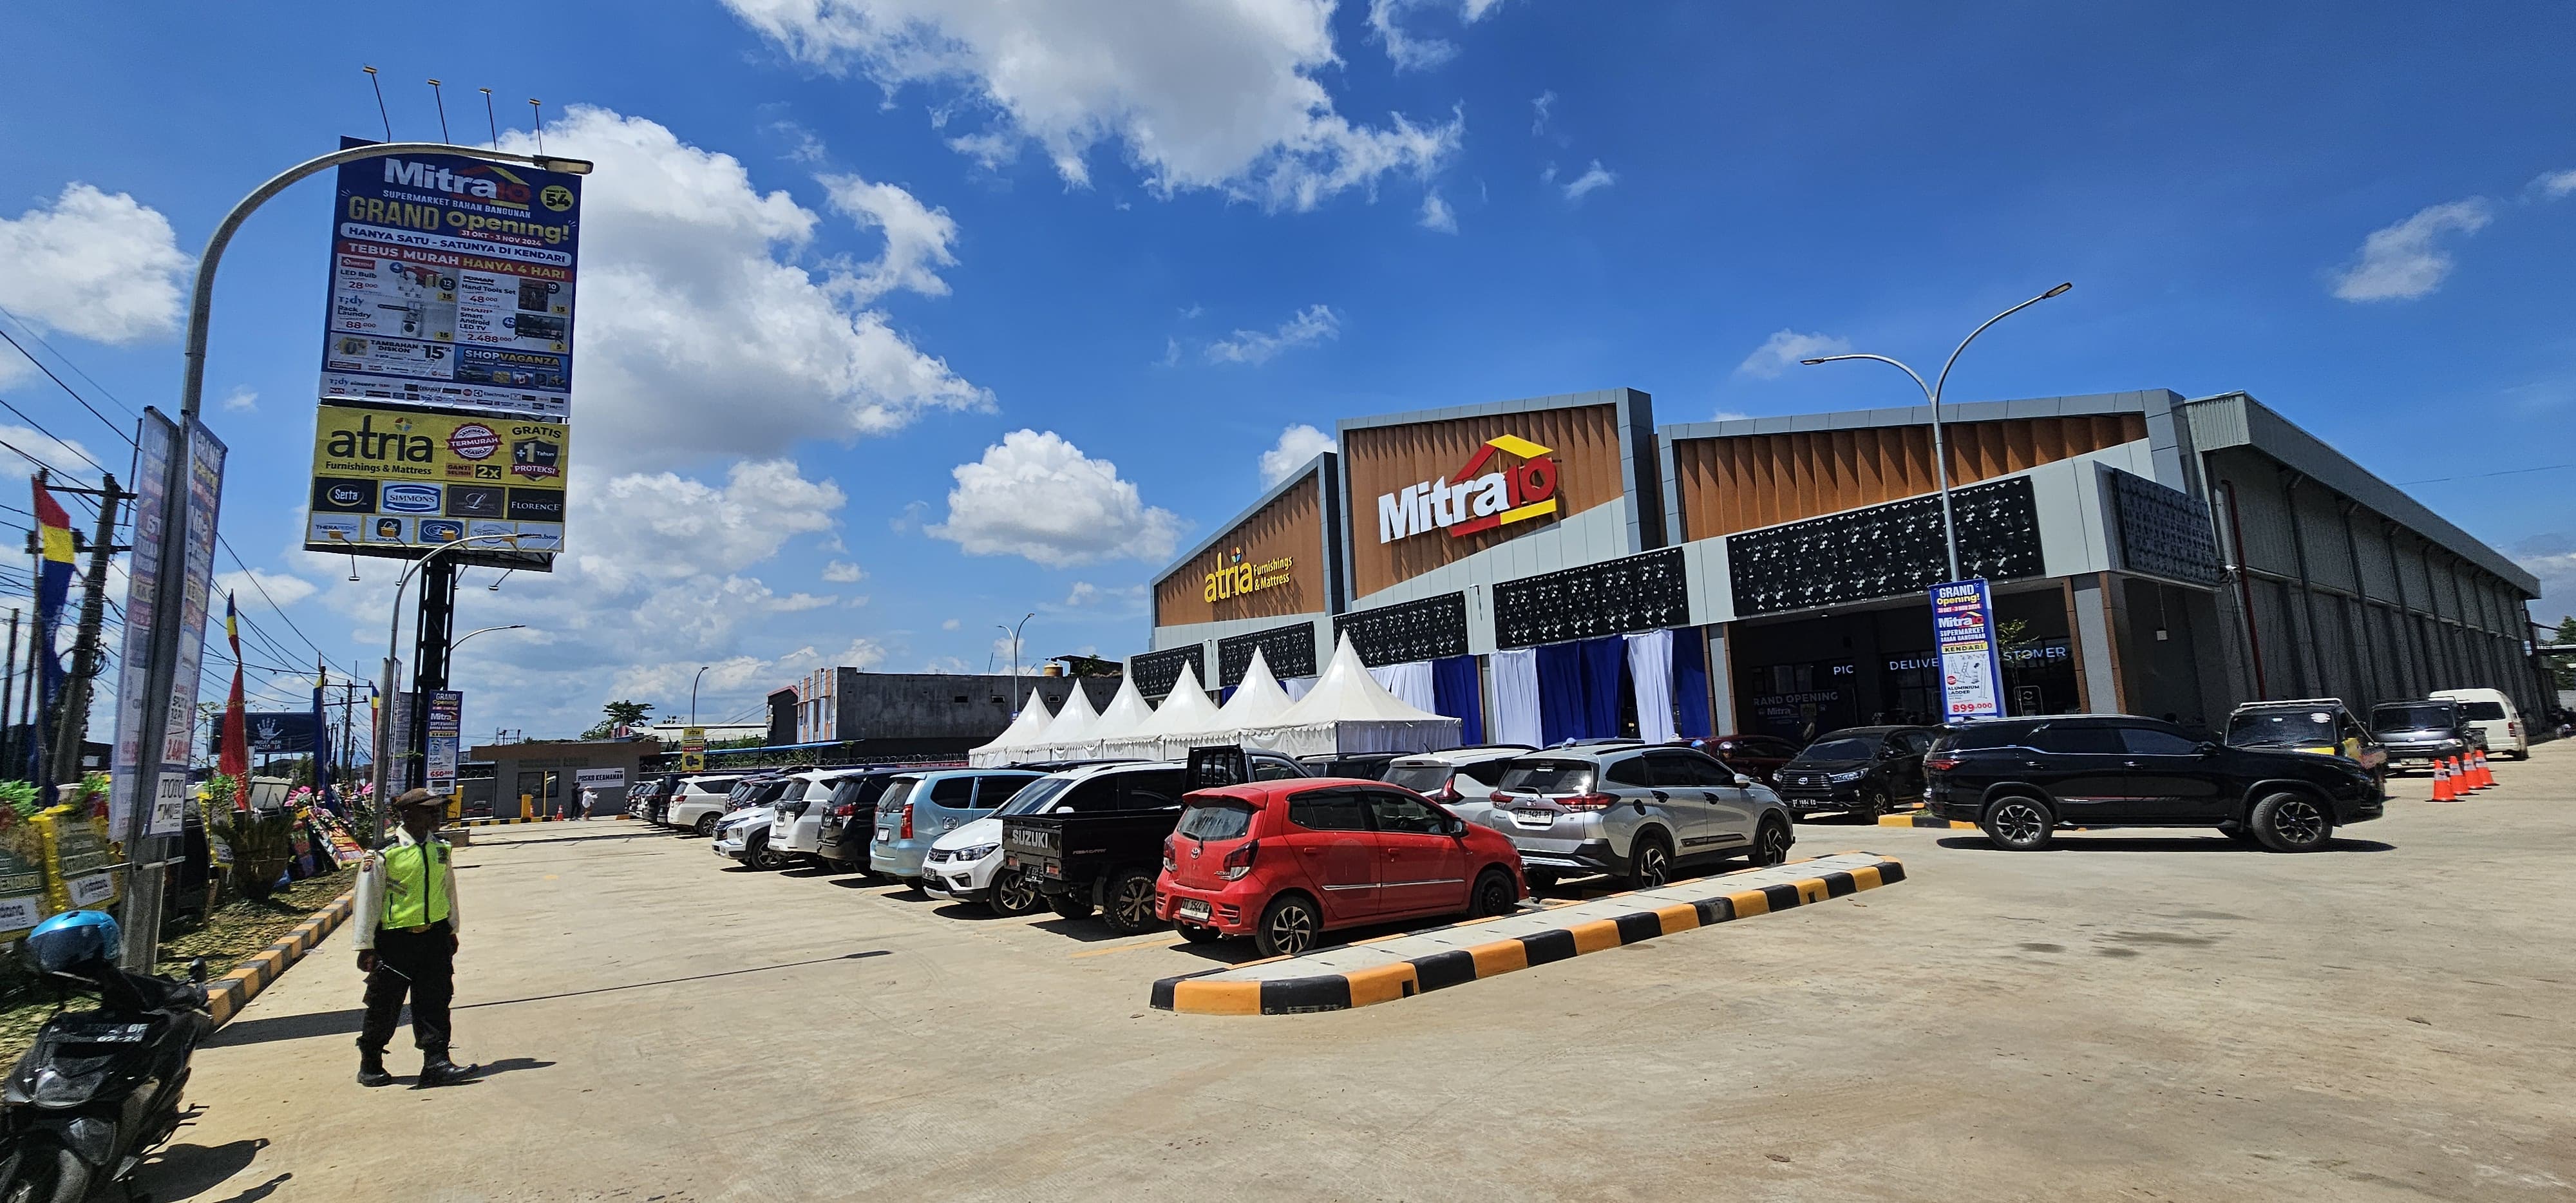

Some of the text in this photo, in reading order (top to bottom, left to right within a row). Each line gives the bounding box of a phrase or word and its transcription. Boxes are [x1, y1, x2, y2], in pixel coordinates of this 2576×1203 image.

[383, 190, 531, 219] SUPERMARKET BAHAN BANGUNAN
[546, 193, 571, 207] 54
[348, 196, 570, 245] GRAND Opening!
[348, 226, 393, 242] HANYA
[397, 232, 430, 245] SATU
[440, 239, 497, 255] SATUNYA
[499, 246, 511, 256] DI
[514, 248, 566, 263] KENDARI
[472, 231, 489, 240] OKT
[502, 235, 520, 245] NOV
[522, 238, 542, 247] 2024
[348, 242, 565, 279] TEBUS MURAH HANYA 4 HARI
[484, 285, 502, 294] Tools
[337, 310, 372, 319] Laundry
[460, 317, 490, 326] Android
[370, 339, 419, 350] TAMBAHAN
[464, 350, 560, 366] SHOPVAGANZA
[327, 415, 433, 463] atria
[512, 426, 562, 439] GRATIS
[451, 437, 498, 447] TERMURAH
[326, 461, 381, 473] Furnishings
[392, 465, 432, 475] Mattress
[515, 465, 556, 475] PROTEKSI
[335, 489, 358, 500] Serta
[390, 495, 435, 503] SIMMONS
[1378, 457, 1558, 544] Mitra10
[511, 501, 562, 511] FLORENCE
[1253, 556, 1293, 576] Furnishings
[1204, 552, 1253, 603] atria
[1255, 573, 1290, 591] & Mattress
[1939, 585, 1975, 598] GRAND
[1937, 592, 1980, 607] Opening!
[1938, 616, 1984, 628] Mitra10
[1940, 627, 1985, 637] SUPERMARKET
[2003, 647, 2066, 661] STOMER
[1833, 665, 1854, 676] PIC
[1889, 658, 1938, 670] DELIVE
[1753, 691, 1839, 706] RAND OPENING
[1012, 829, 1048, 849] SUZUKI
